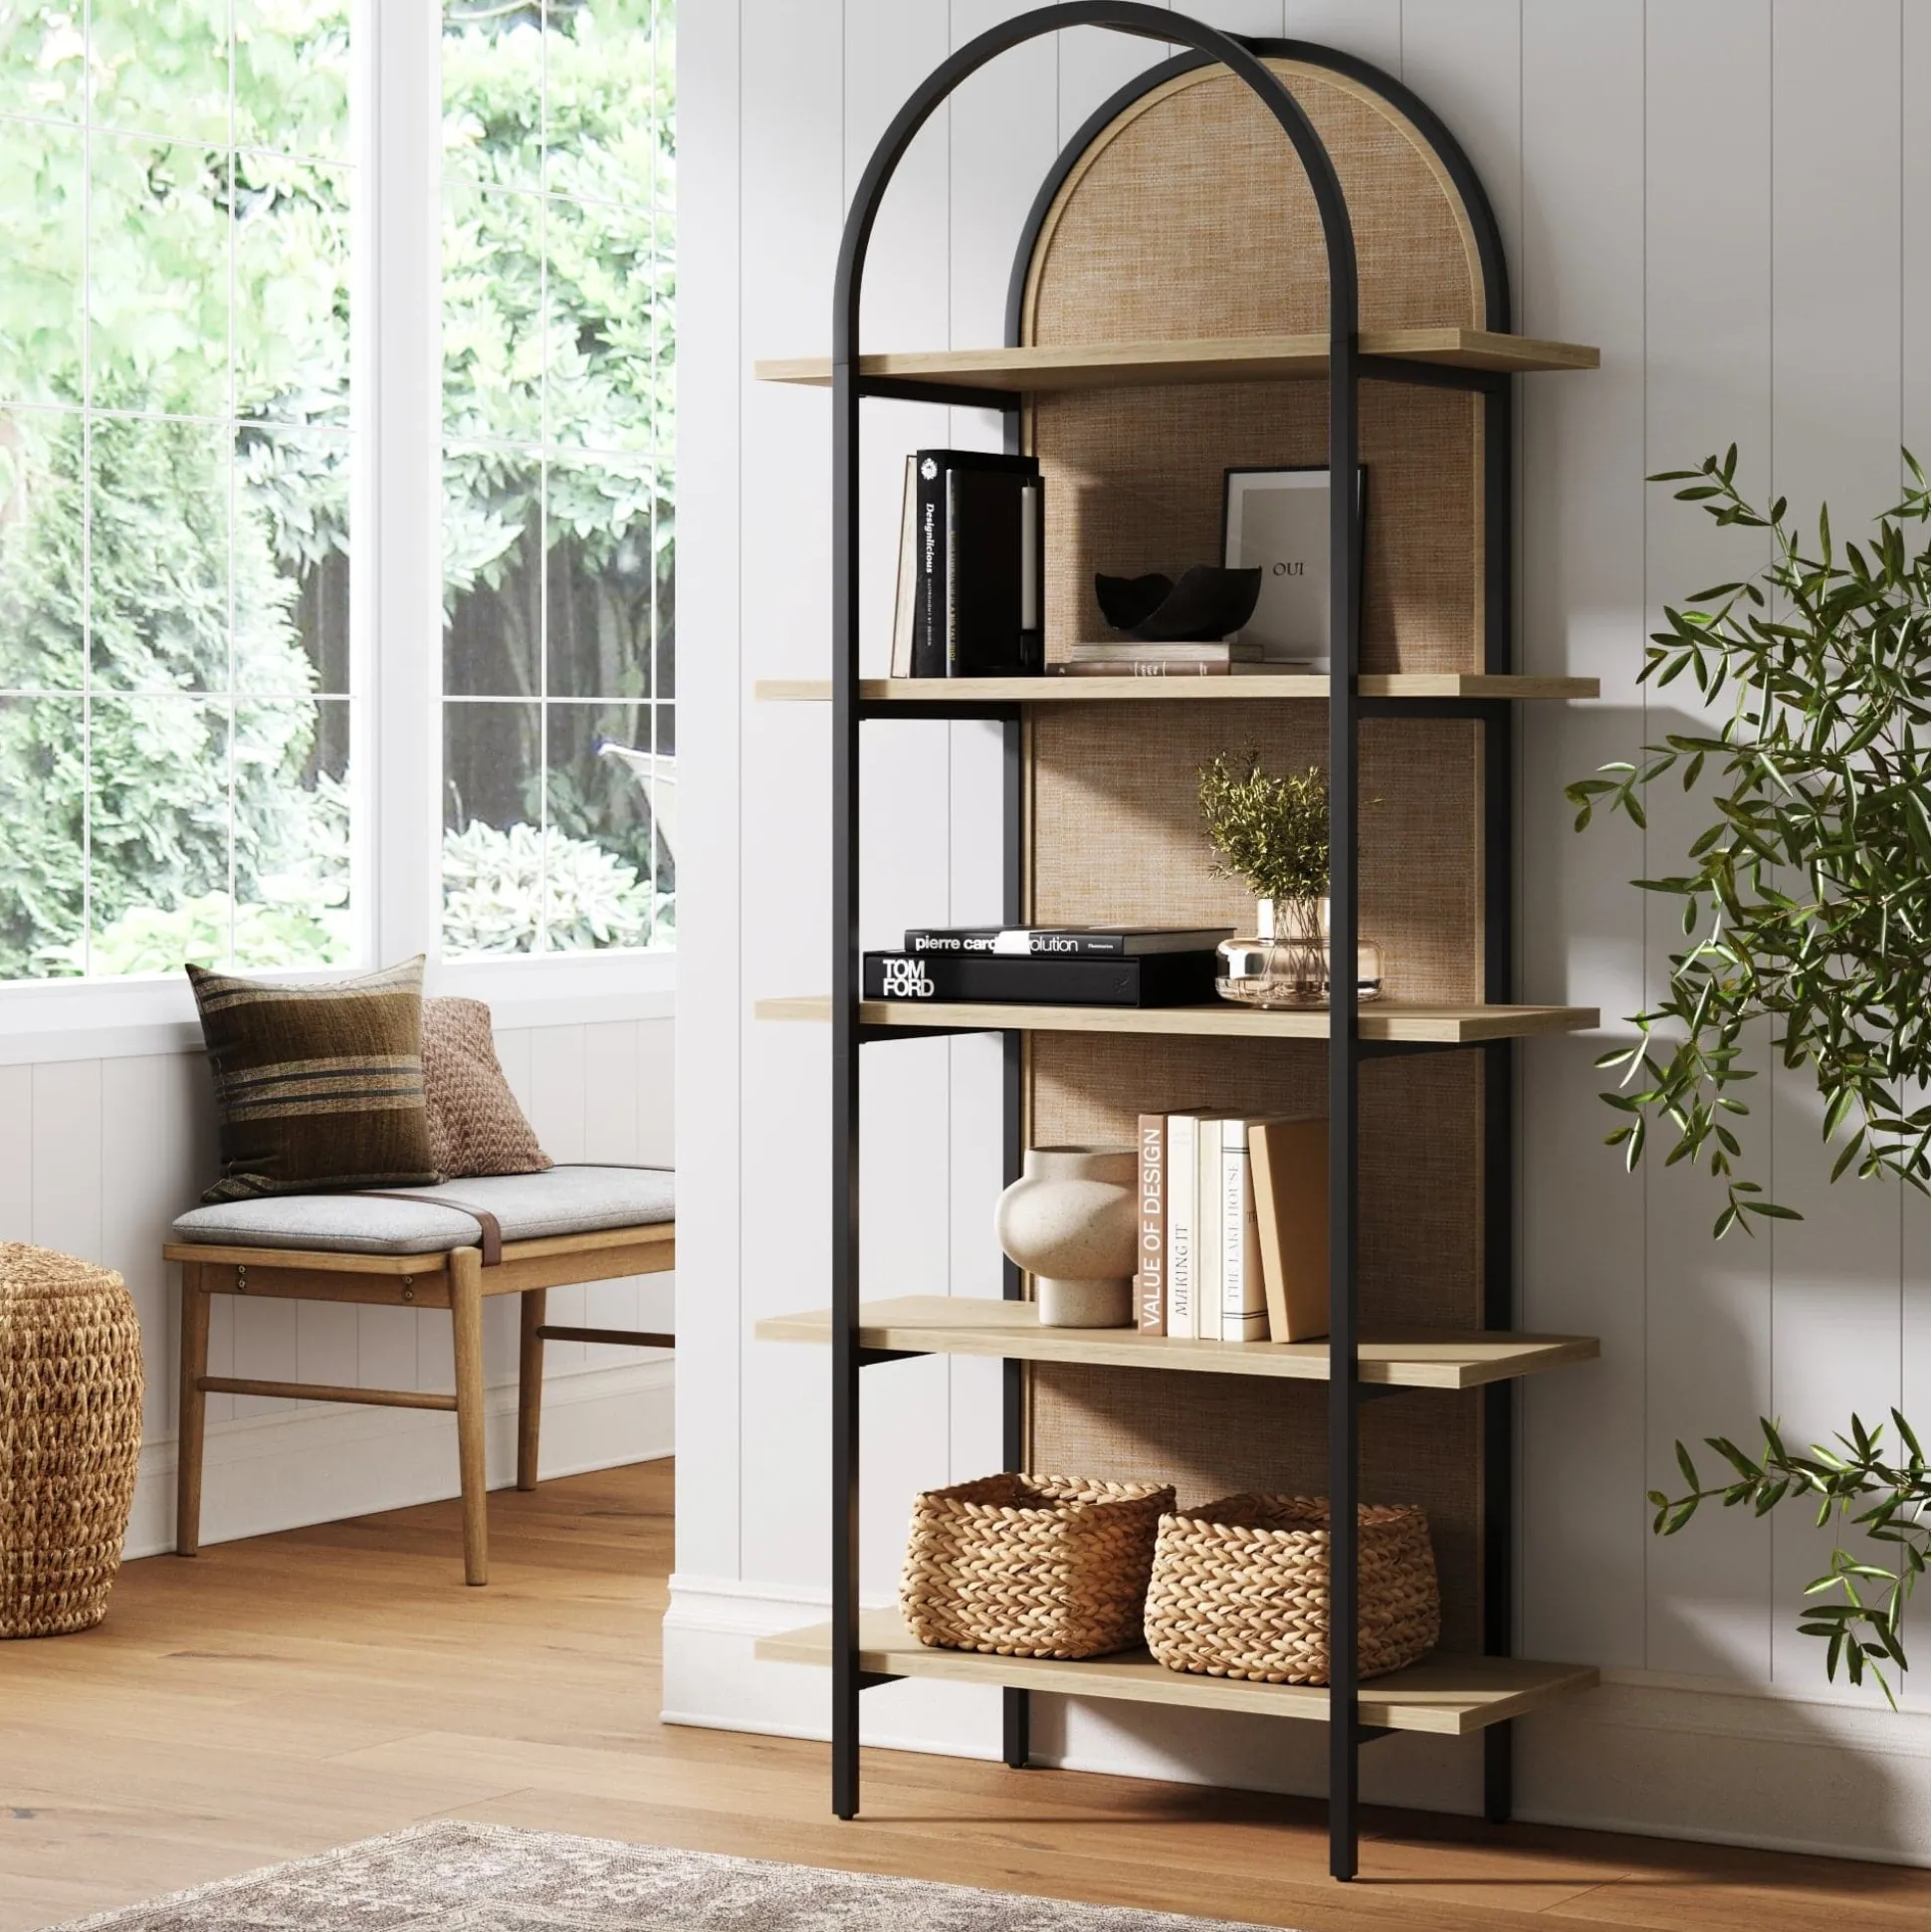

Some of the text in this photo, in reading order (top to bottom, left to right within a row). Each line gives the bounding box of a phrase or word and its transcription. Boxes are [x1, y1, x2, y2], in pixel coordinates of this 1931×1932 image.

[924, 503, 935, 573] Designlicious
[1272, 561, 1304, 576] OUI
[915, 935, 961, 951] pierre
[963, 936, 999, 951] card
[1029, 936, 1079, 952] olution
[883, 959, 926, 978] TOM
[883, 977, 935, 996] FORD
[1143, 1129, 1161, 1328] VALUE OF DESIGN
[1228, 1162, 1239, 1302] THE LAKE HOUSE
[1175, 1223, 1188, 1316] MAKING IT
